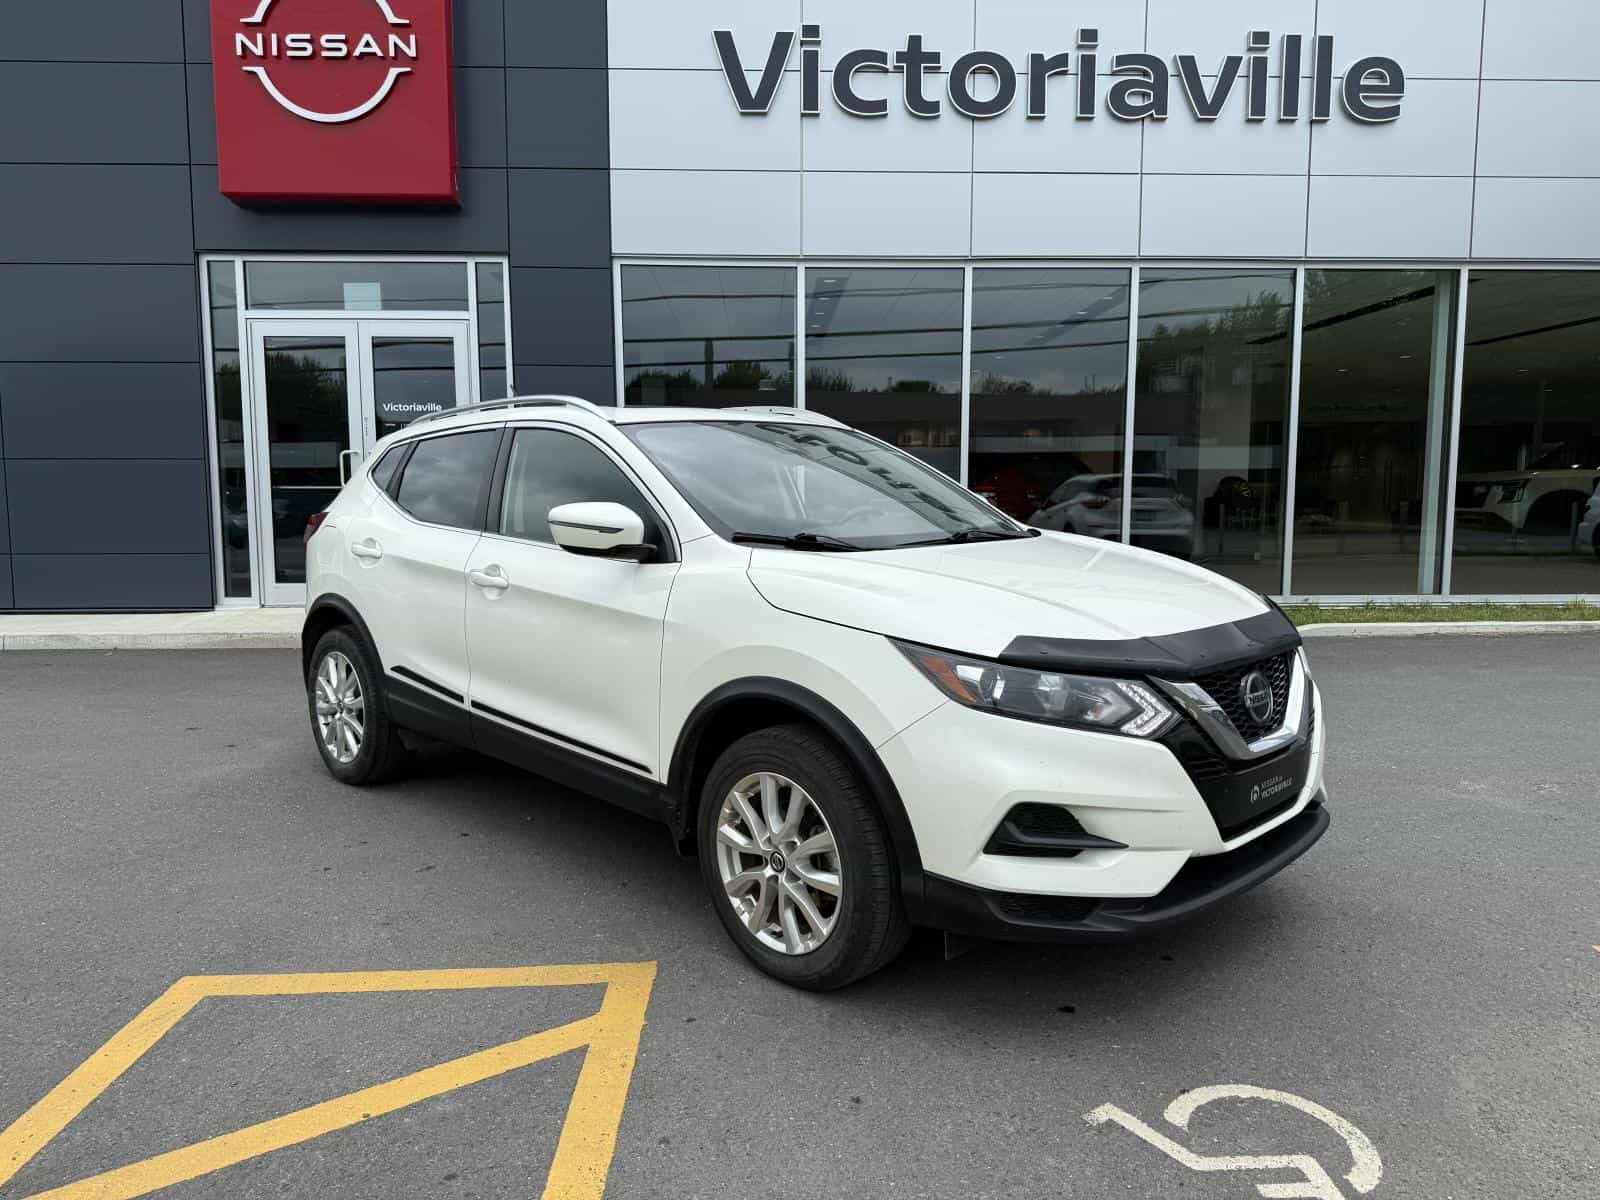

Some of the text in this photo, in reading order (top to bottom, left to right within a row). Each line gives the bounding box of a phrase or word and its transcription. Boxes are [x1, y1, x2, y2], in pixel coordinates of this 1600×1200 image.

[235, 33, 417, 57] NISSAN
[713, 25, 1405, 124] Victoriaville
[383, 402, 442, 412] Victoriaville
